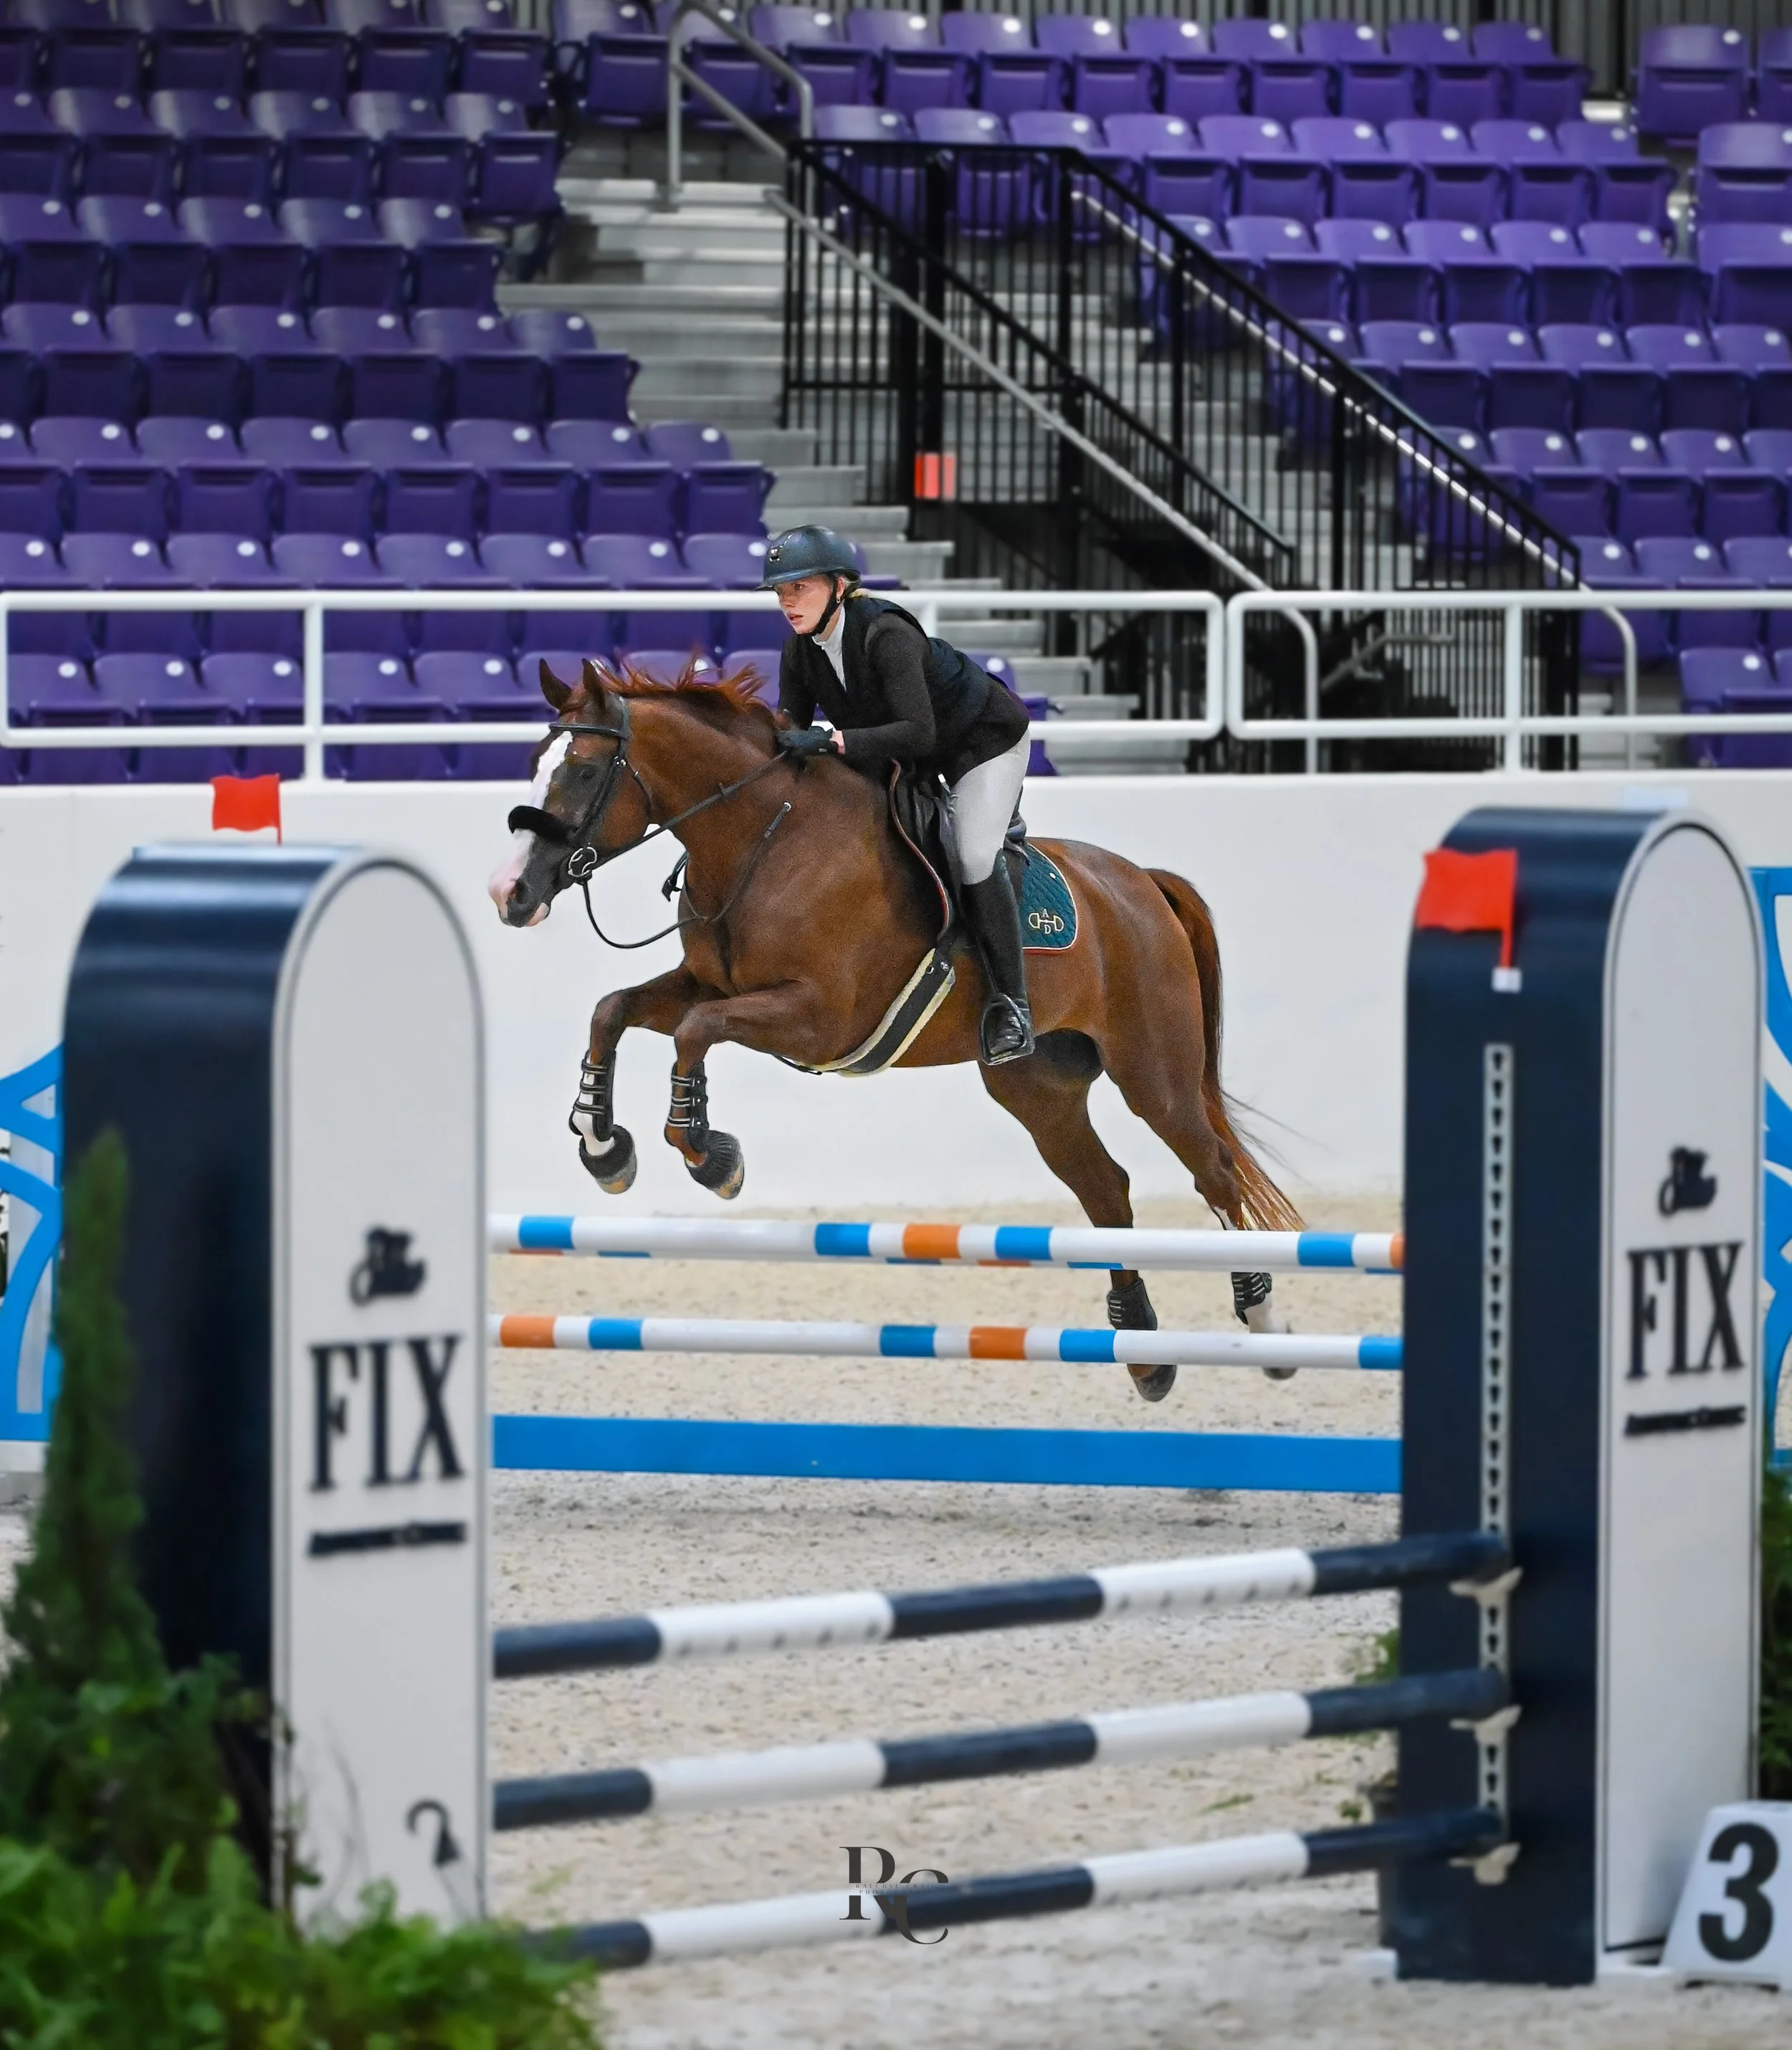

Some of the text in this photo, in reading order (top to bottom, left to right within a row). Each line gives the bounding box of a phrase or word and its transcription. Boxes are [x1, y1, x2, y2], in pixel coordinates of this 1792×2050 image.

[1042, 908, 1049, 917] A
[1044, 924, 1052, 934] D
[1626, 1241, 1745, 1381] FIX
[309, 1334, 464, 1493] FIX
[1698, 1821, 1779, 1963] 3
